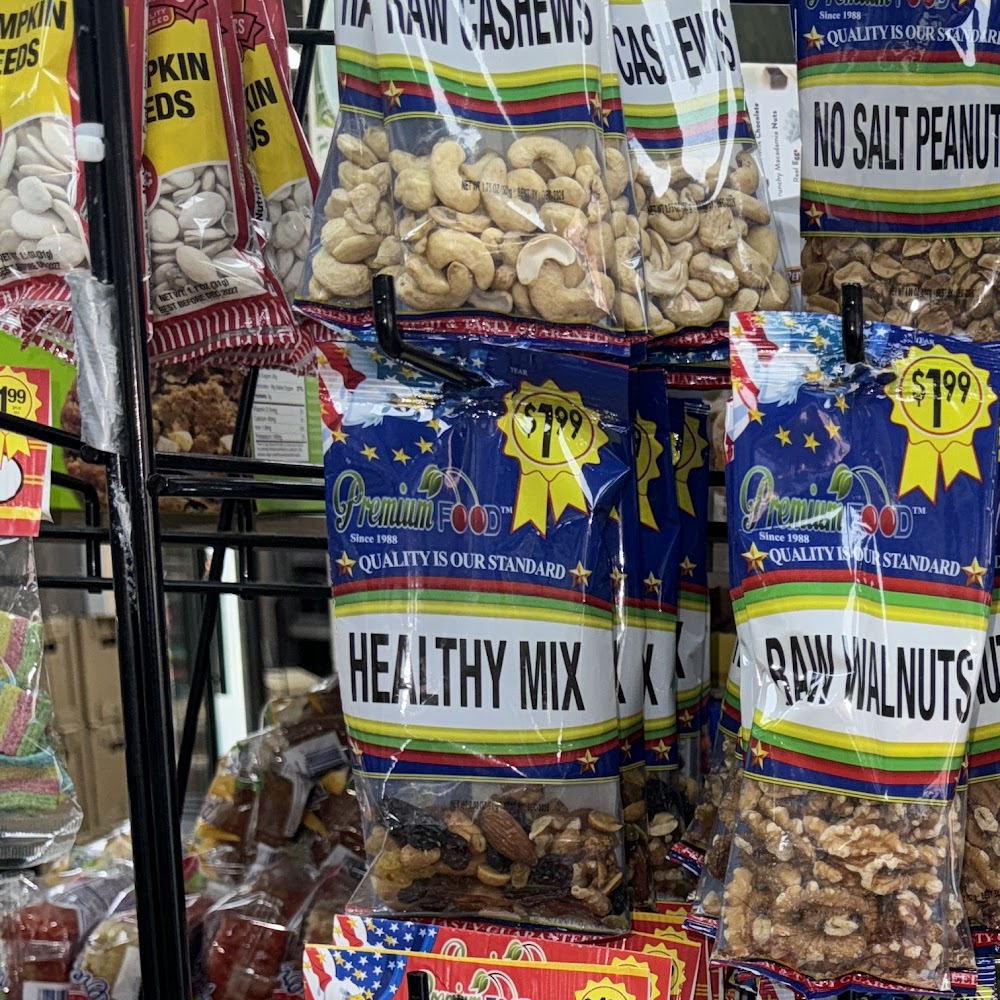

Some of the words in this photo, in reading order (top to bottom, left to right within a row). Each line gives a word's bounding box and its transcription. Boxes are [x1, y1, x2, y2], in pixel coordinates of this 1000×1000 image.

[459, 0, 593, 51] CASHEWS
[819, 11, 839, 20] Since
[842, 11, 862, 21] 1988
[827, 25, 888, 46] QUALITY
[890, 25, 903, 41] IS
[905, 25, 934, 42] OUR
[612, 7, 736, 86] CASHEWS
[814, 100, 846, 168] NO
[853, 102, 910, 171] SALT
[333, 468, 434, 534] Premium
[437, 502, 501, 536] FOOD
[740, 465, 843, 535] Premium
[350, 533, 374, 544] Since
[376, 534, 398, 545] 1988
[759, 531, 784, 543] Since
[787, 533, 811, 544] 1988
[768, 547, 833, 565] QUALITY
[835, 547, 851, 563] IS
[853, 547, 880, 567] OUR
[882, 551, 961, 578] STANDARD
[359, 551, 431, 573] QUALITY
[433, 550, 448, 568] IS
[450, 551, 487, 569] OUR
[488, 554, 567, 580] STANDARD
[349, 632, 507, 709] HEALTHY
[519, 640, 586, 711] MIX
[765, 634, 835, 707] RAW
[842, 634, 973, 723] WALNUTS
